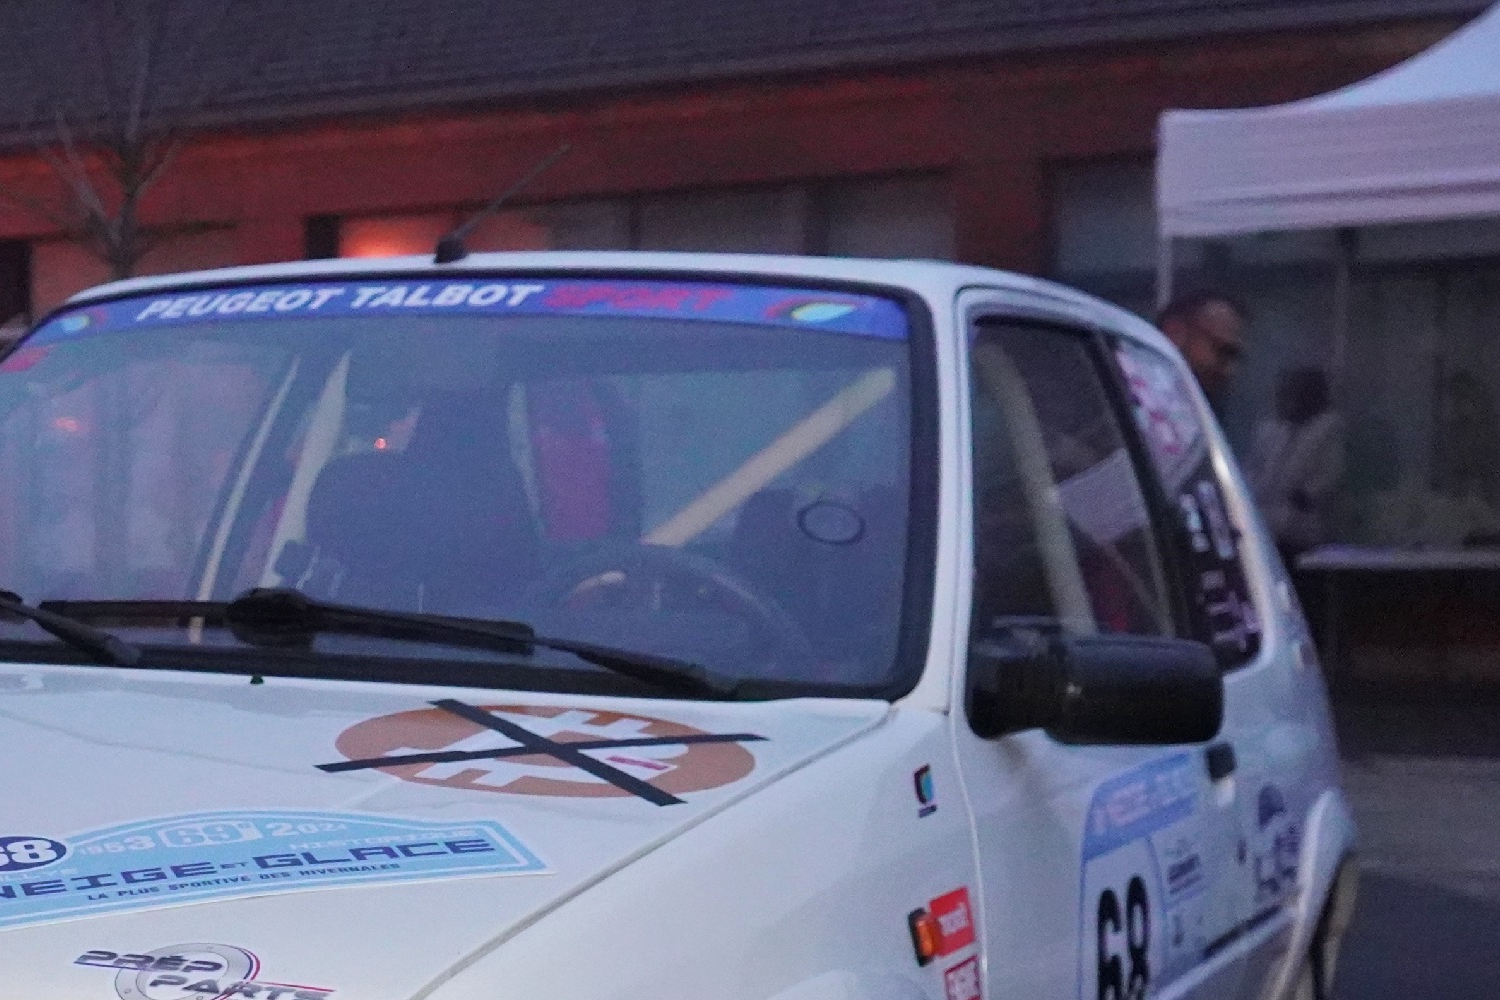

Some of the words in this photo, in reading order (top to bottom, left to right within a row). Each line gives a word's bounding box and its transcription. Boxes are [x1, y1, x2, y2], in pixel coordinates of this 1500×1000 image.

[136, 287, 345, 322] PEUGEOT
[351, 284, 545, 309] TALBOT
[545, 285, 733, 312] SPORT
[253, 838, 495, 869] GLACE
[87, 892, 109, 901] LA
[118, 887, 160, 898] PLUS
[169, 874, 251, 891] SPORTIVE
[259, 871, 290, 880] DES
[299, 863, 401, 877] HIVERNALES
